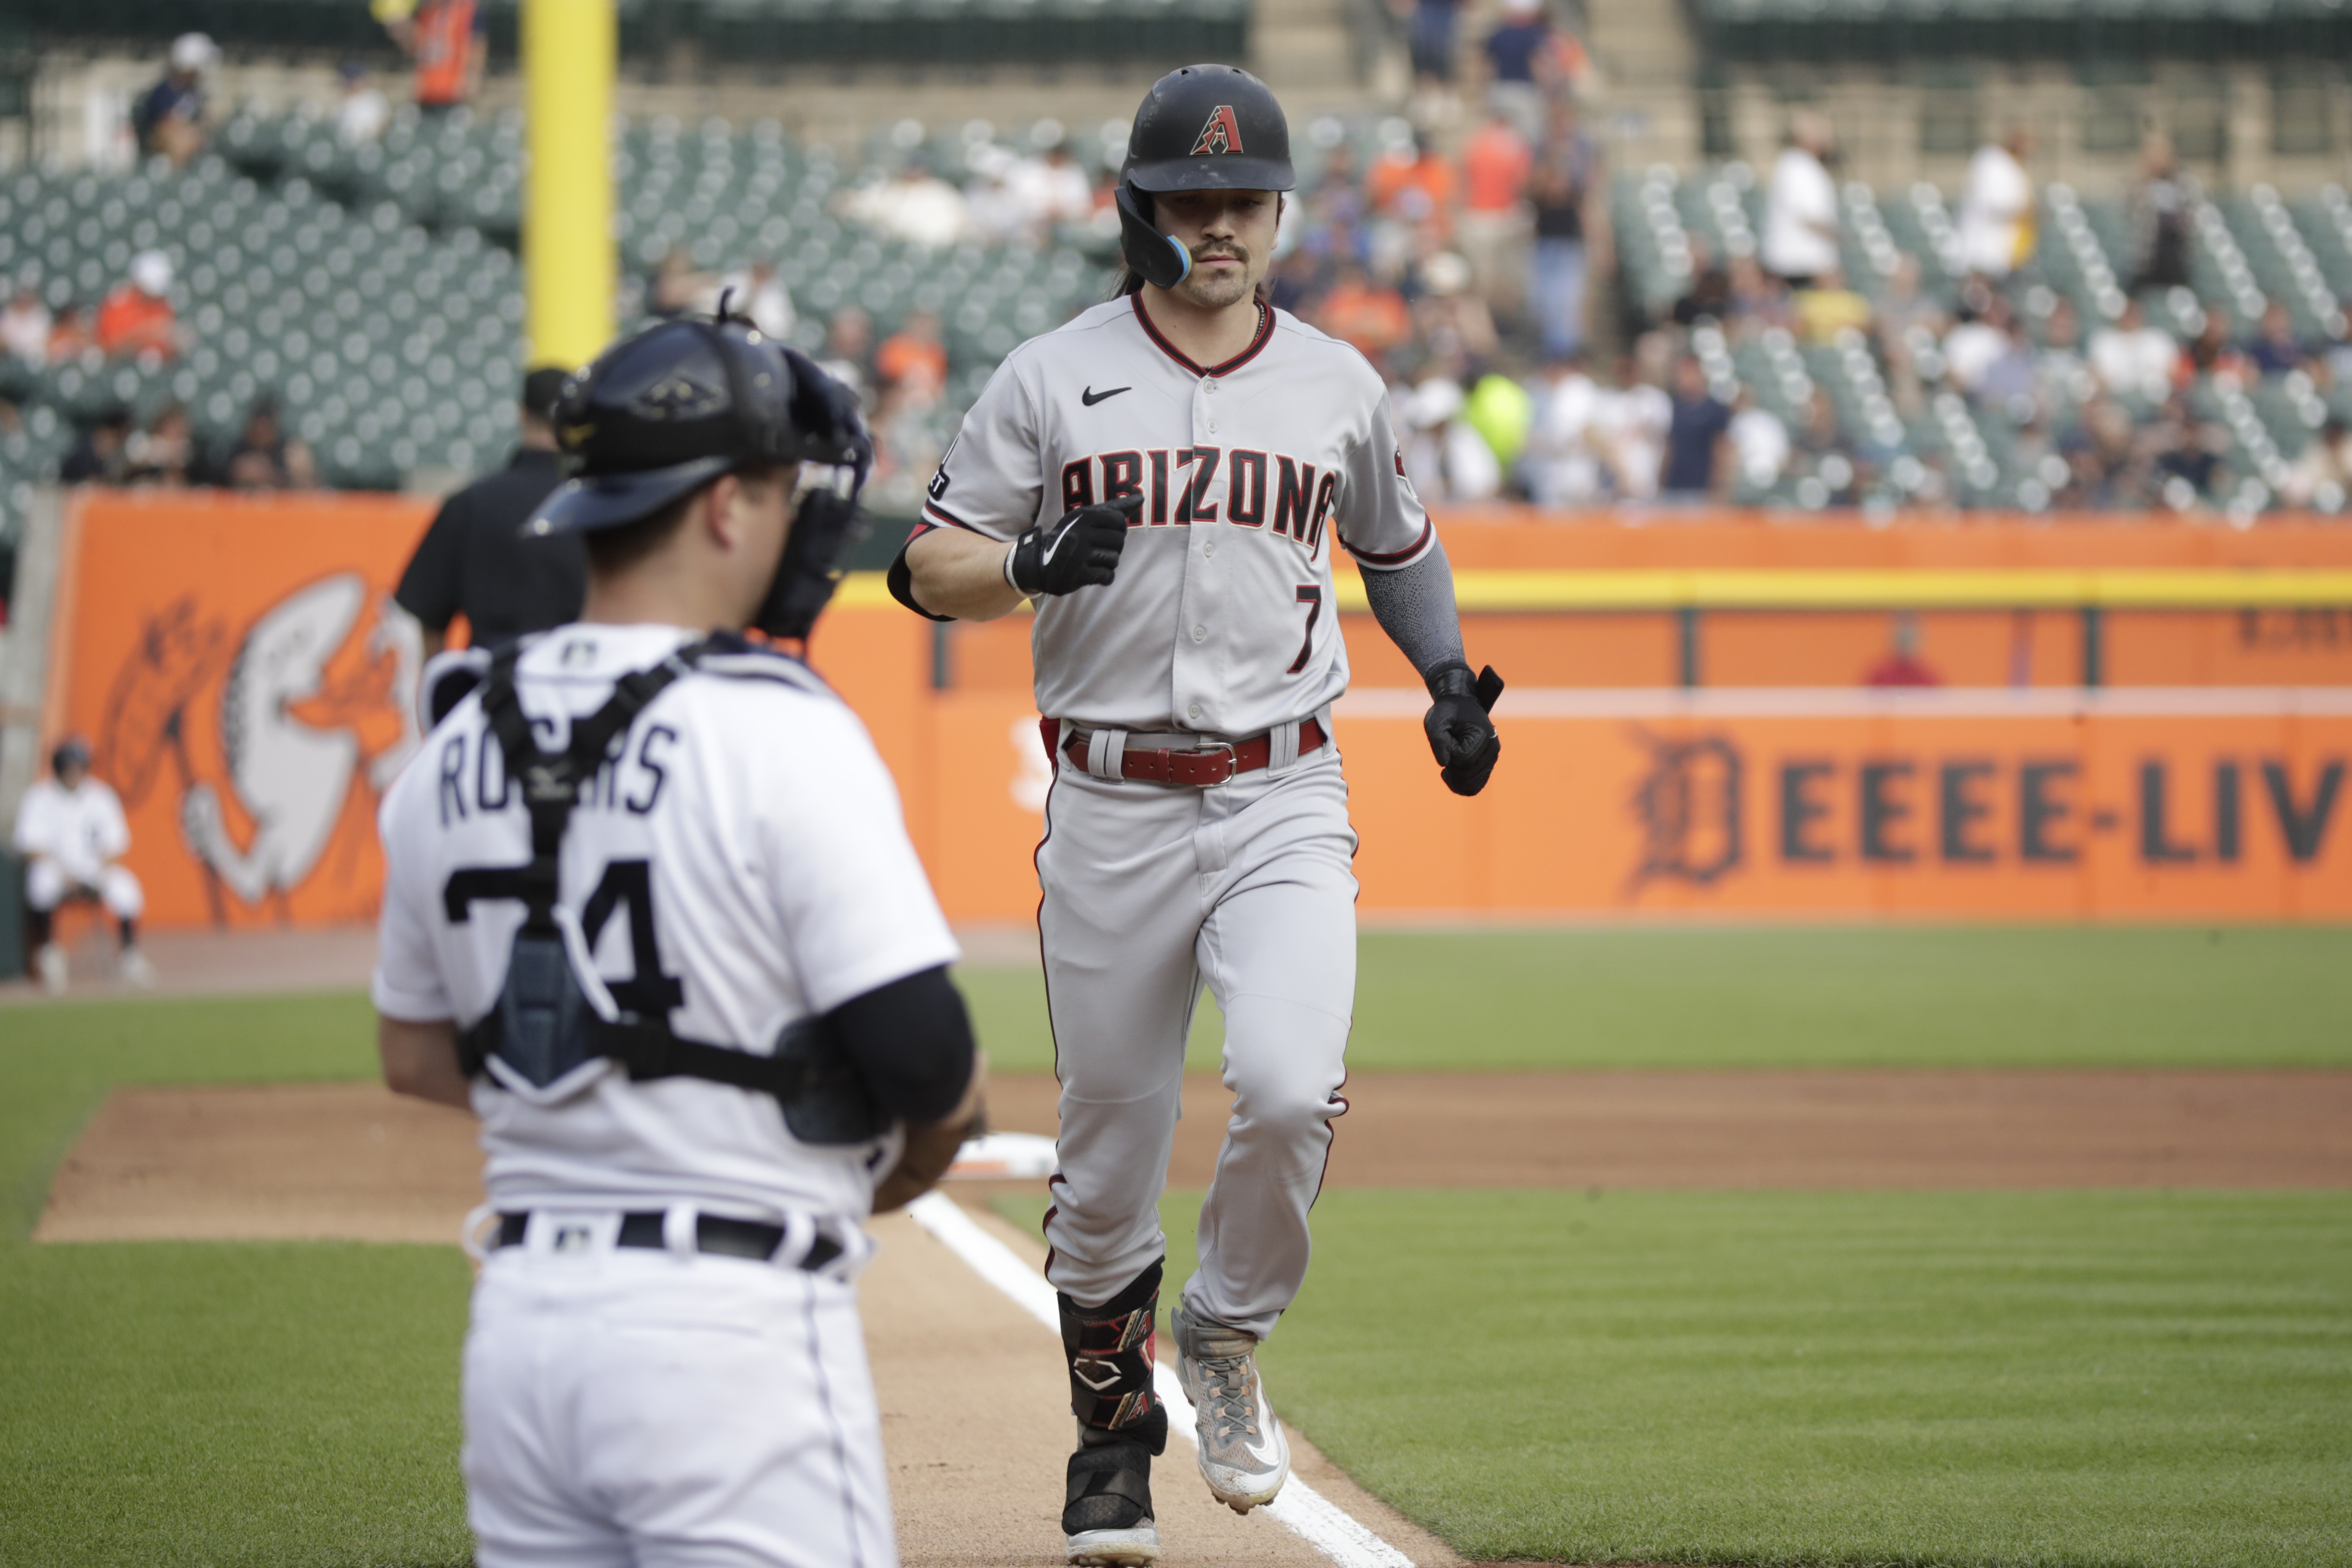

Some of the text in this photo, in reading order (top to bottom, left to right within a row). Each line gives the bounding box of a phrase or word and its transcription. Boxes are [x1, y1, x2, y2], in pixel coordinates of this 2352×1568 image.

[1189, 105, 1243, 155] A
[1062, 443, 1336, 565] ARIZONA
[1287, 584, 1322, 674] 7
